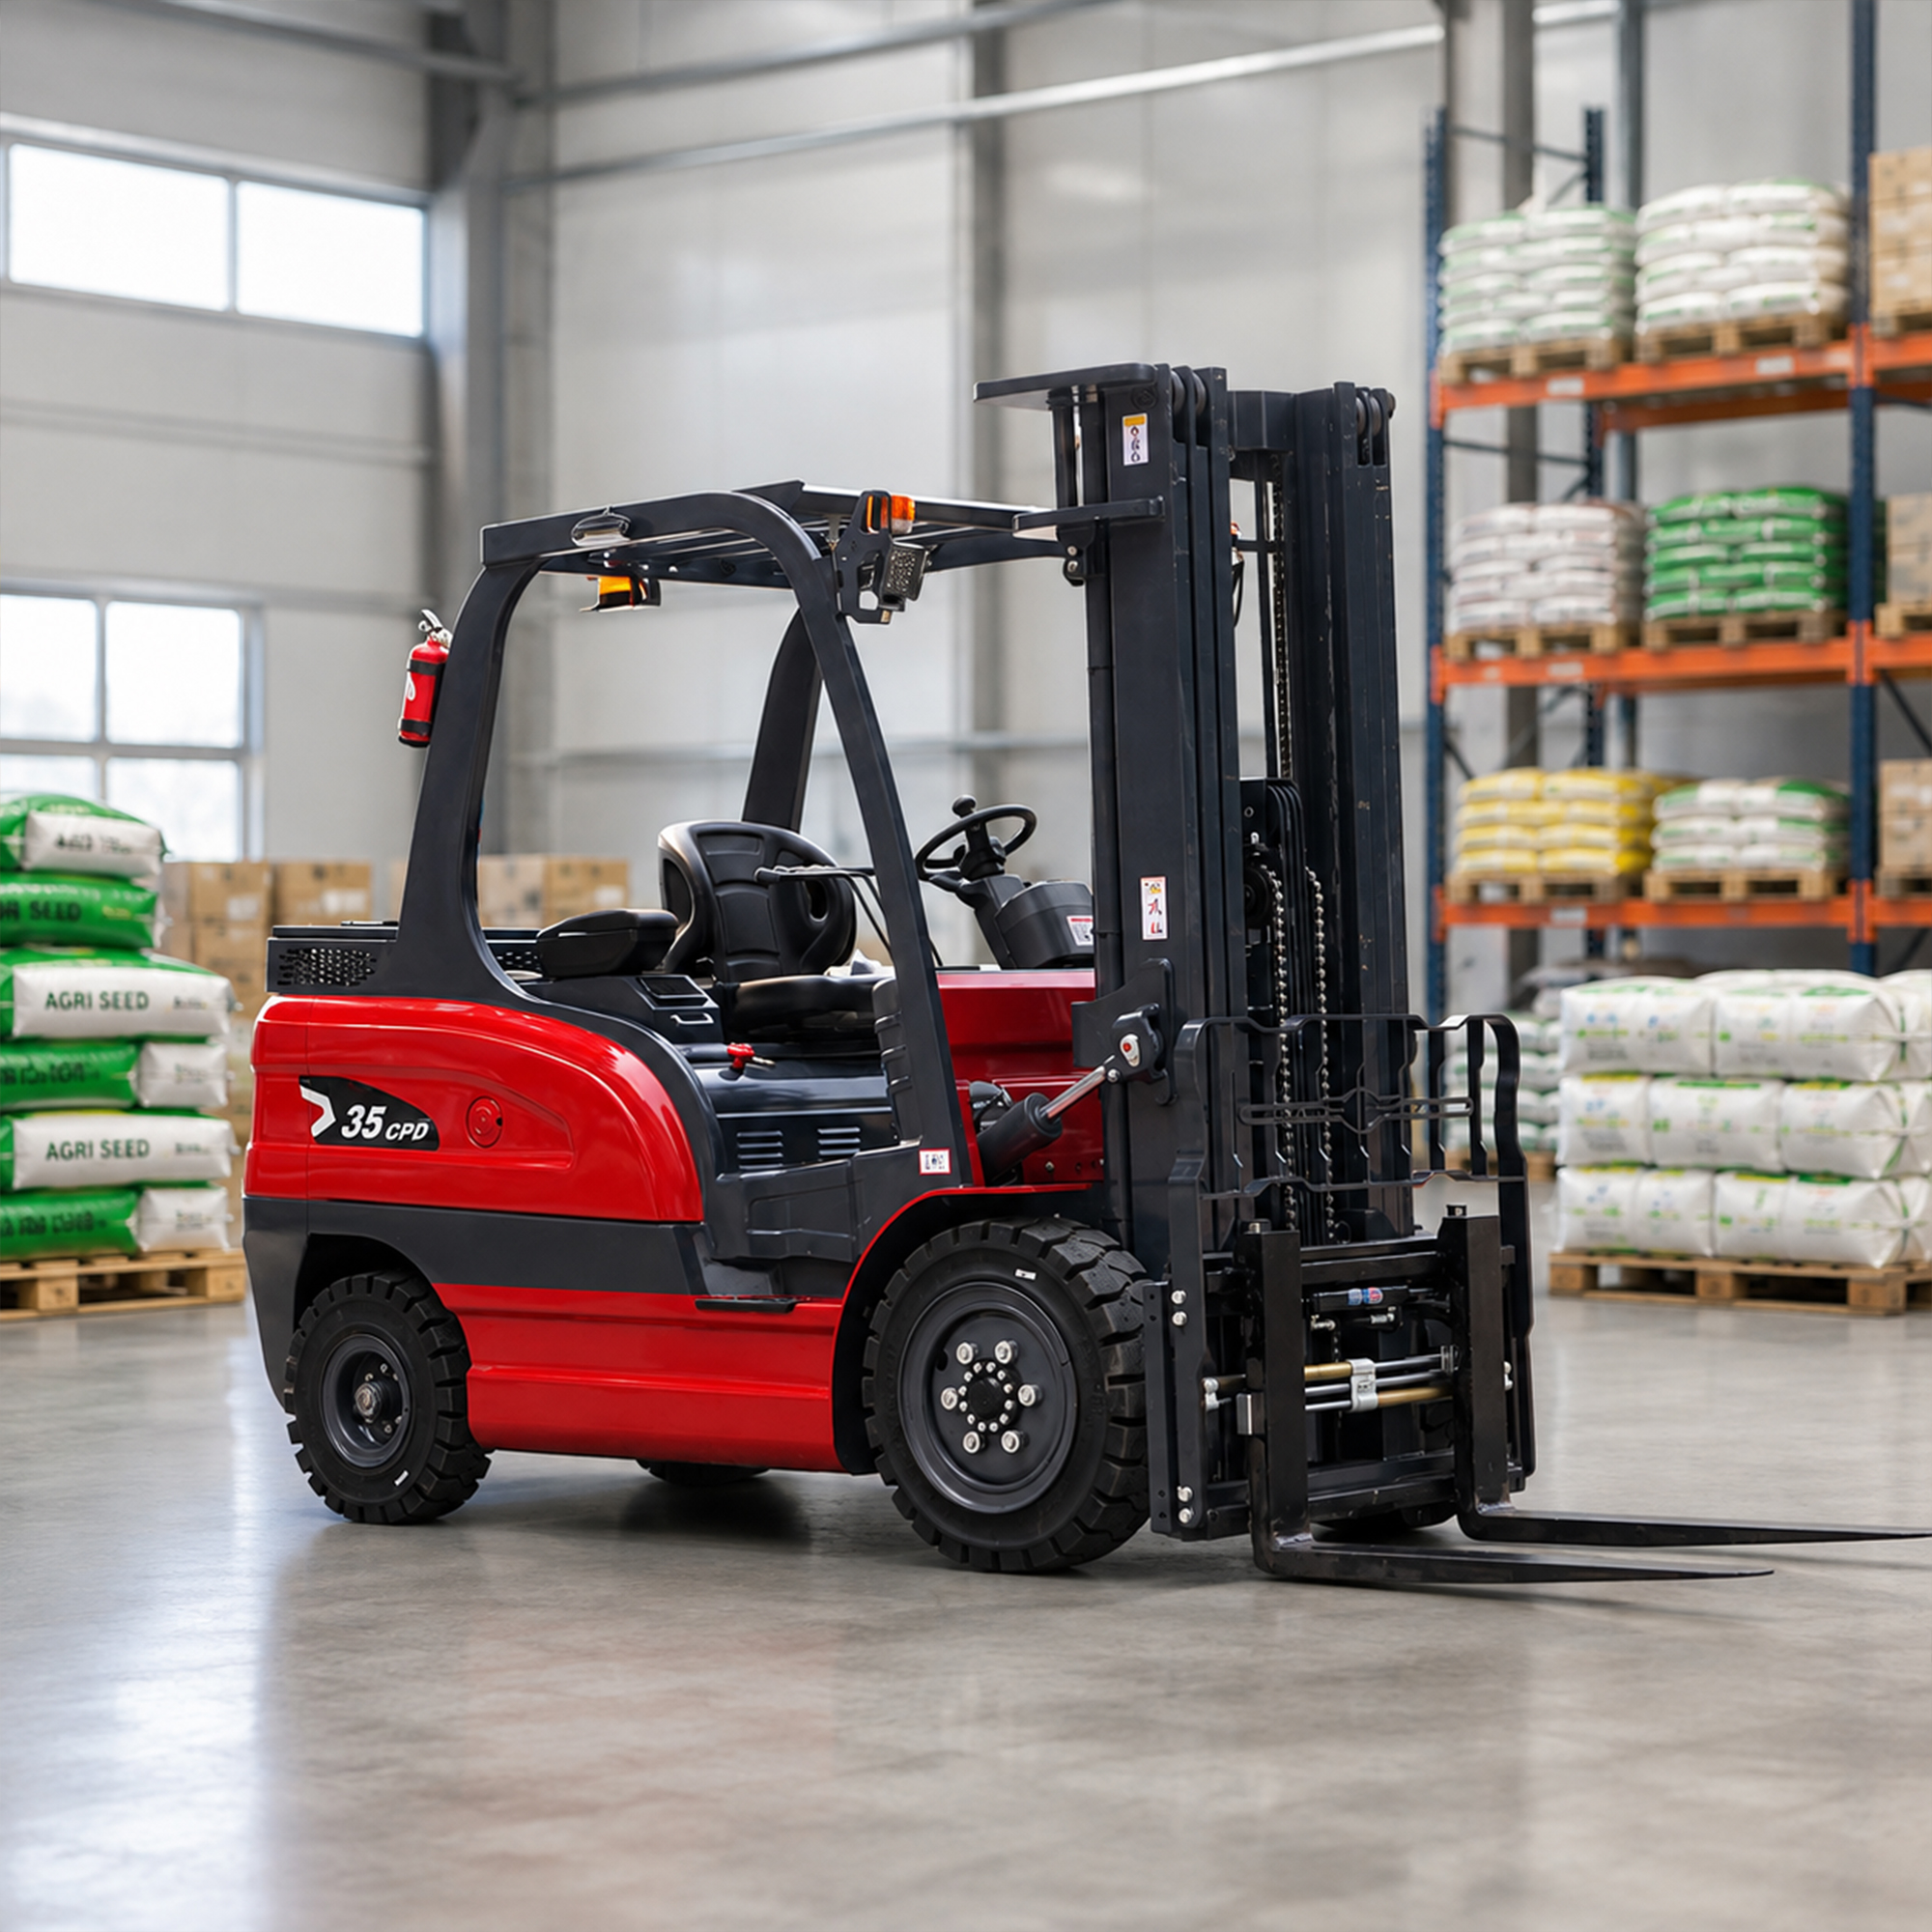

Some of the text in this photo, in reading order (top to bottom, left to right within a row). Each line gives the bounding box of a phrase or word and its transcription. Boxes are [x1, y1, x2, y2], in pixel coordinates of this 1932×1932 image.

[44, 991, 150, 1010] AGRI SEED
[341, 1105, 430, 1141] 35 CPD
[45, 1139, 150, 1160] AGRI SEED
